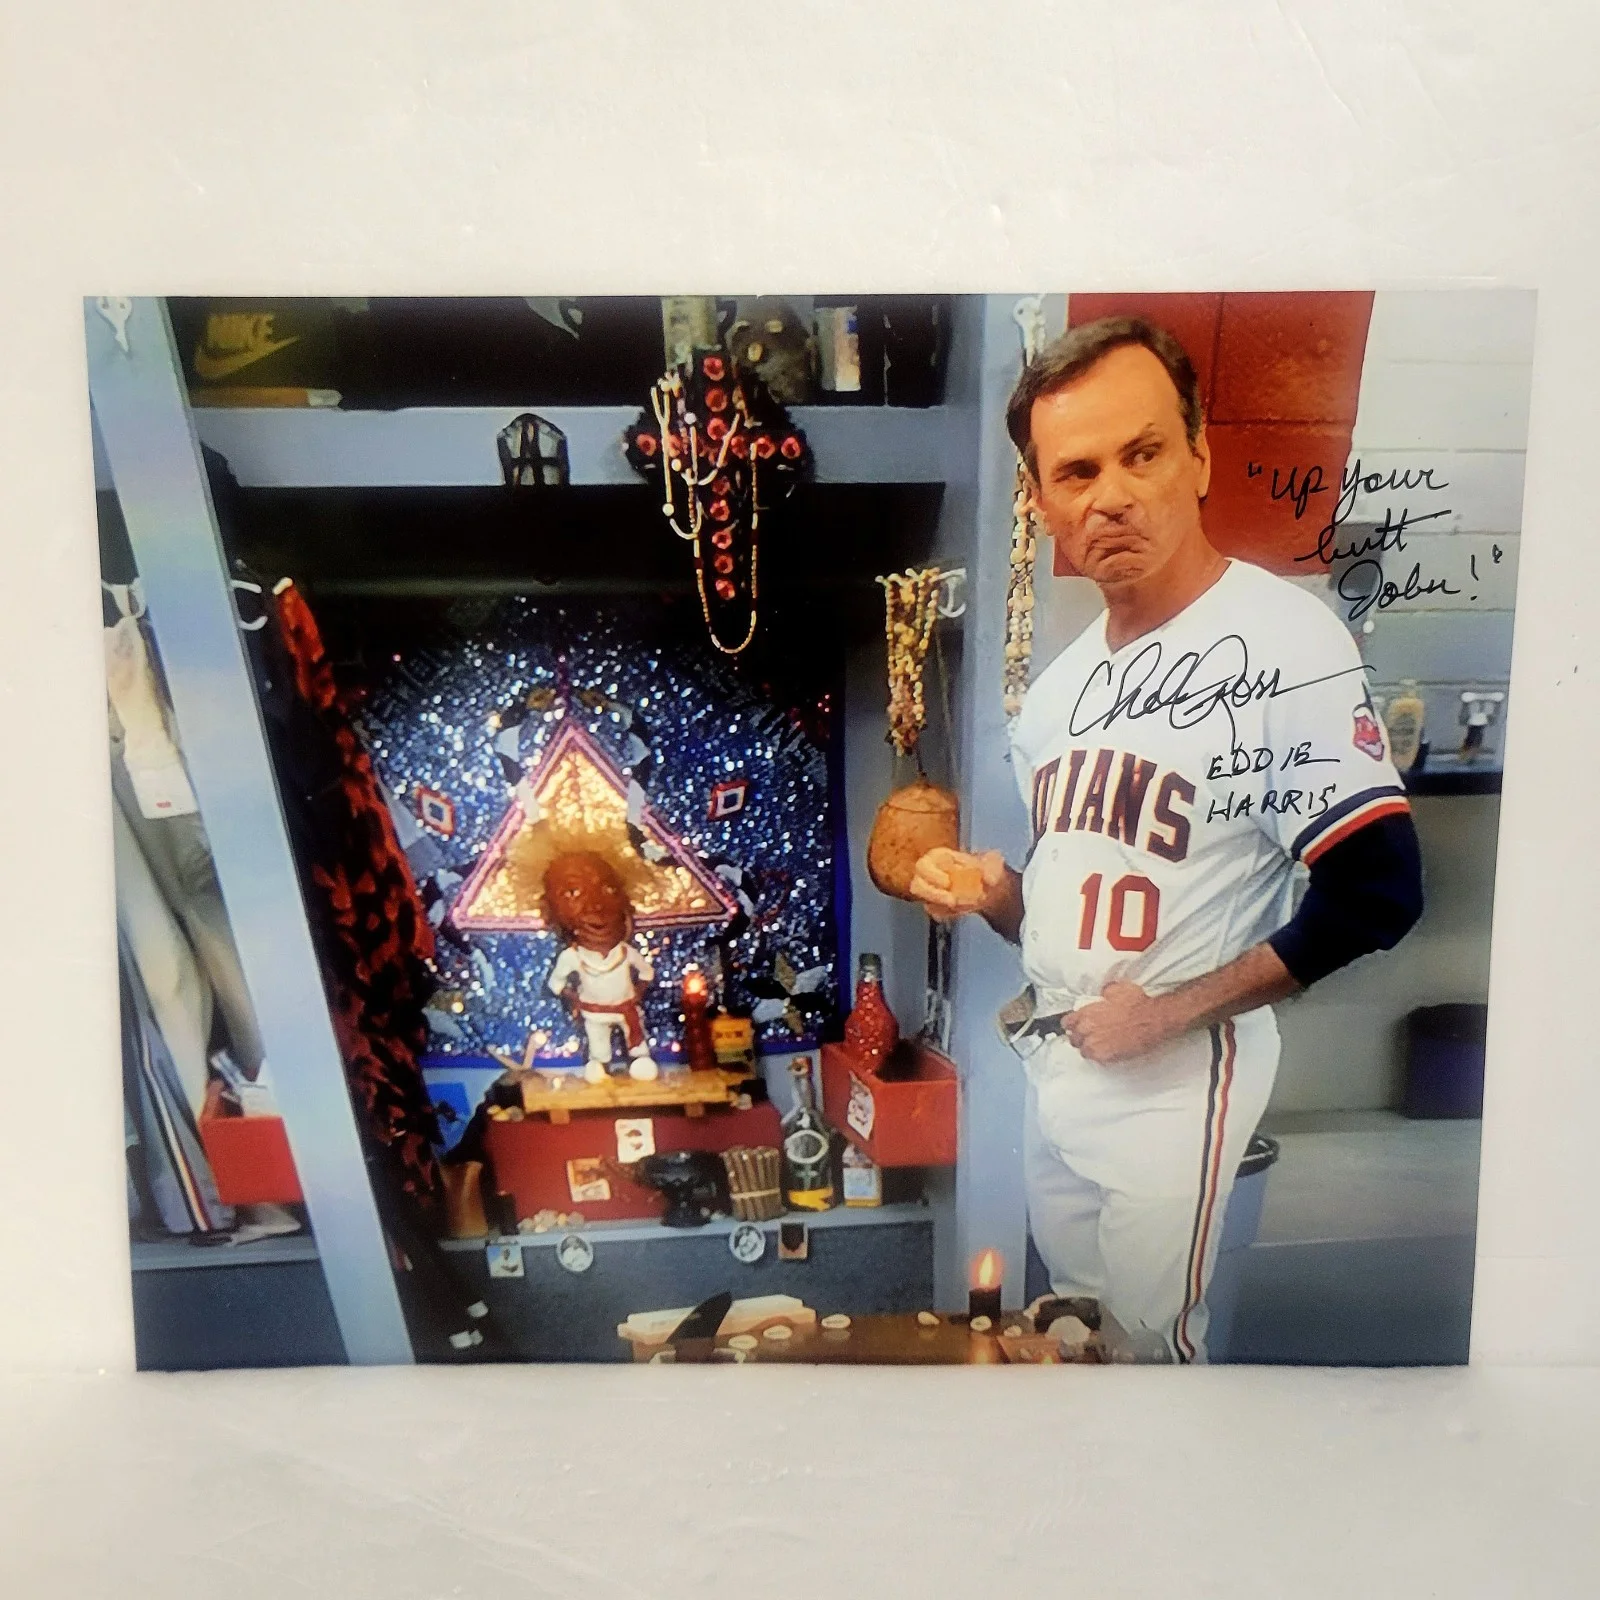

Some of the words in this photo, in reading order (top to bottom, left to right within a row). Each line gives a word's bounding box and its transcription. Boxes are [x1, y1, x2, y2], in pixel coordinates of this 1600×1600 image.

[1206, 741, 1341, 780] EDDIE
[1206, 783, 1337, 824] HARRIS
[1078, 872, 1160, 952] 10
